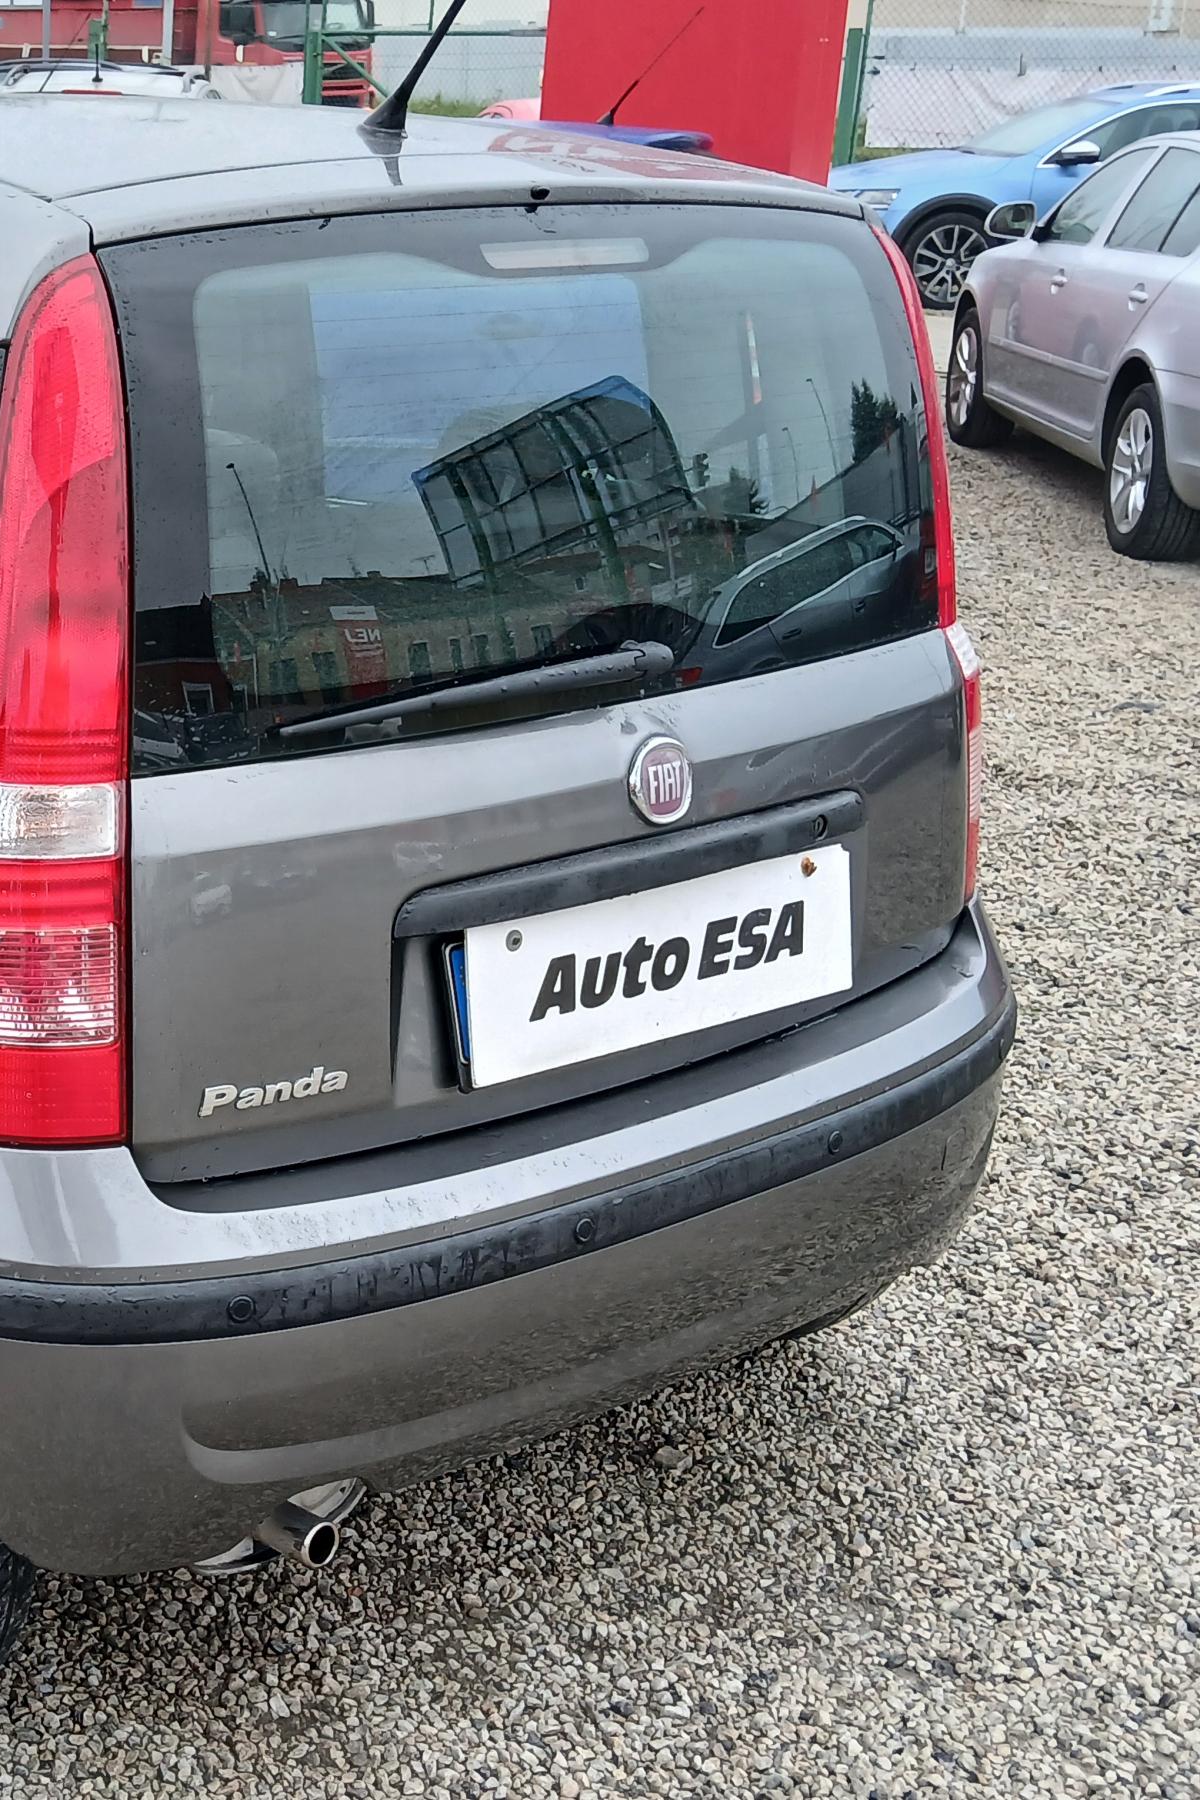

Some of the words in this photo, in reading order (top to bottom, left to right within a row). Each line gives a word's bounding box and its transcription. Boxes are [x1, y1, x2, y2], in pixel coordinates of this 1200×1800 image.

[647, 760, 682, 805] FIAT
[529, 936, 690, 1022] Auto
[696, 900, 804, 980] ESA
[199, 1065, 349, 1118] Panda
